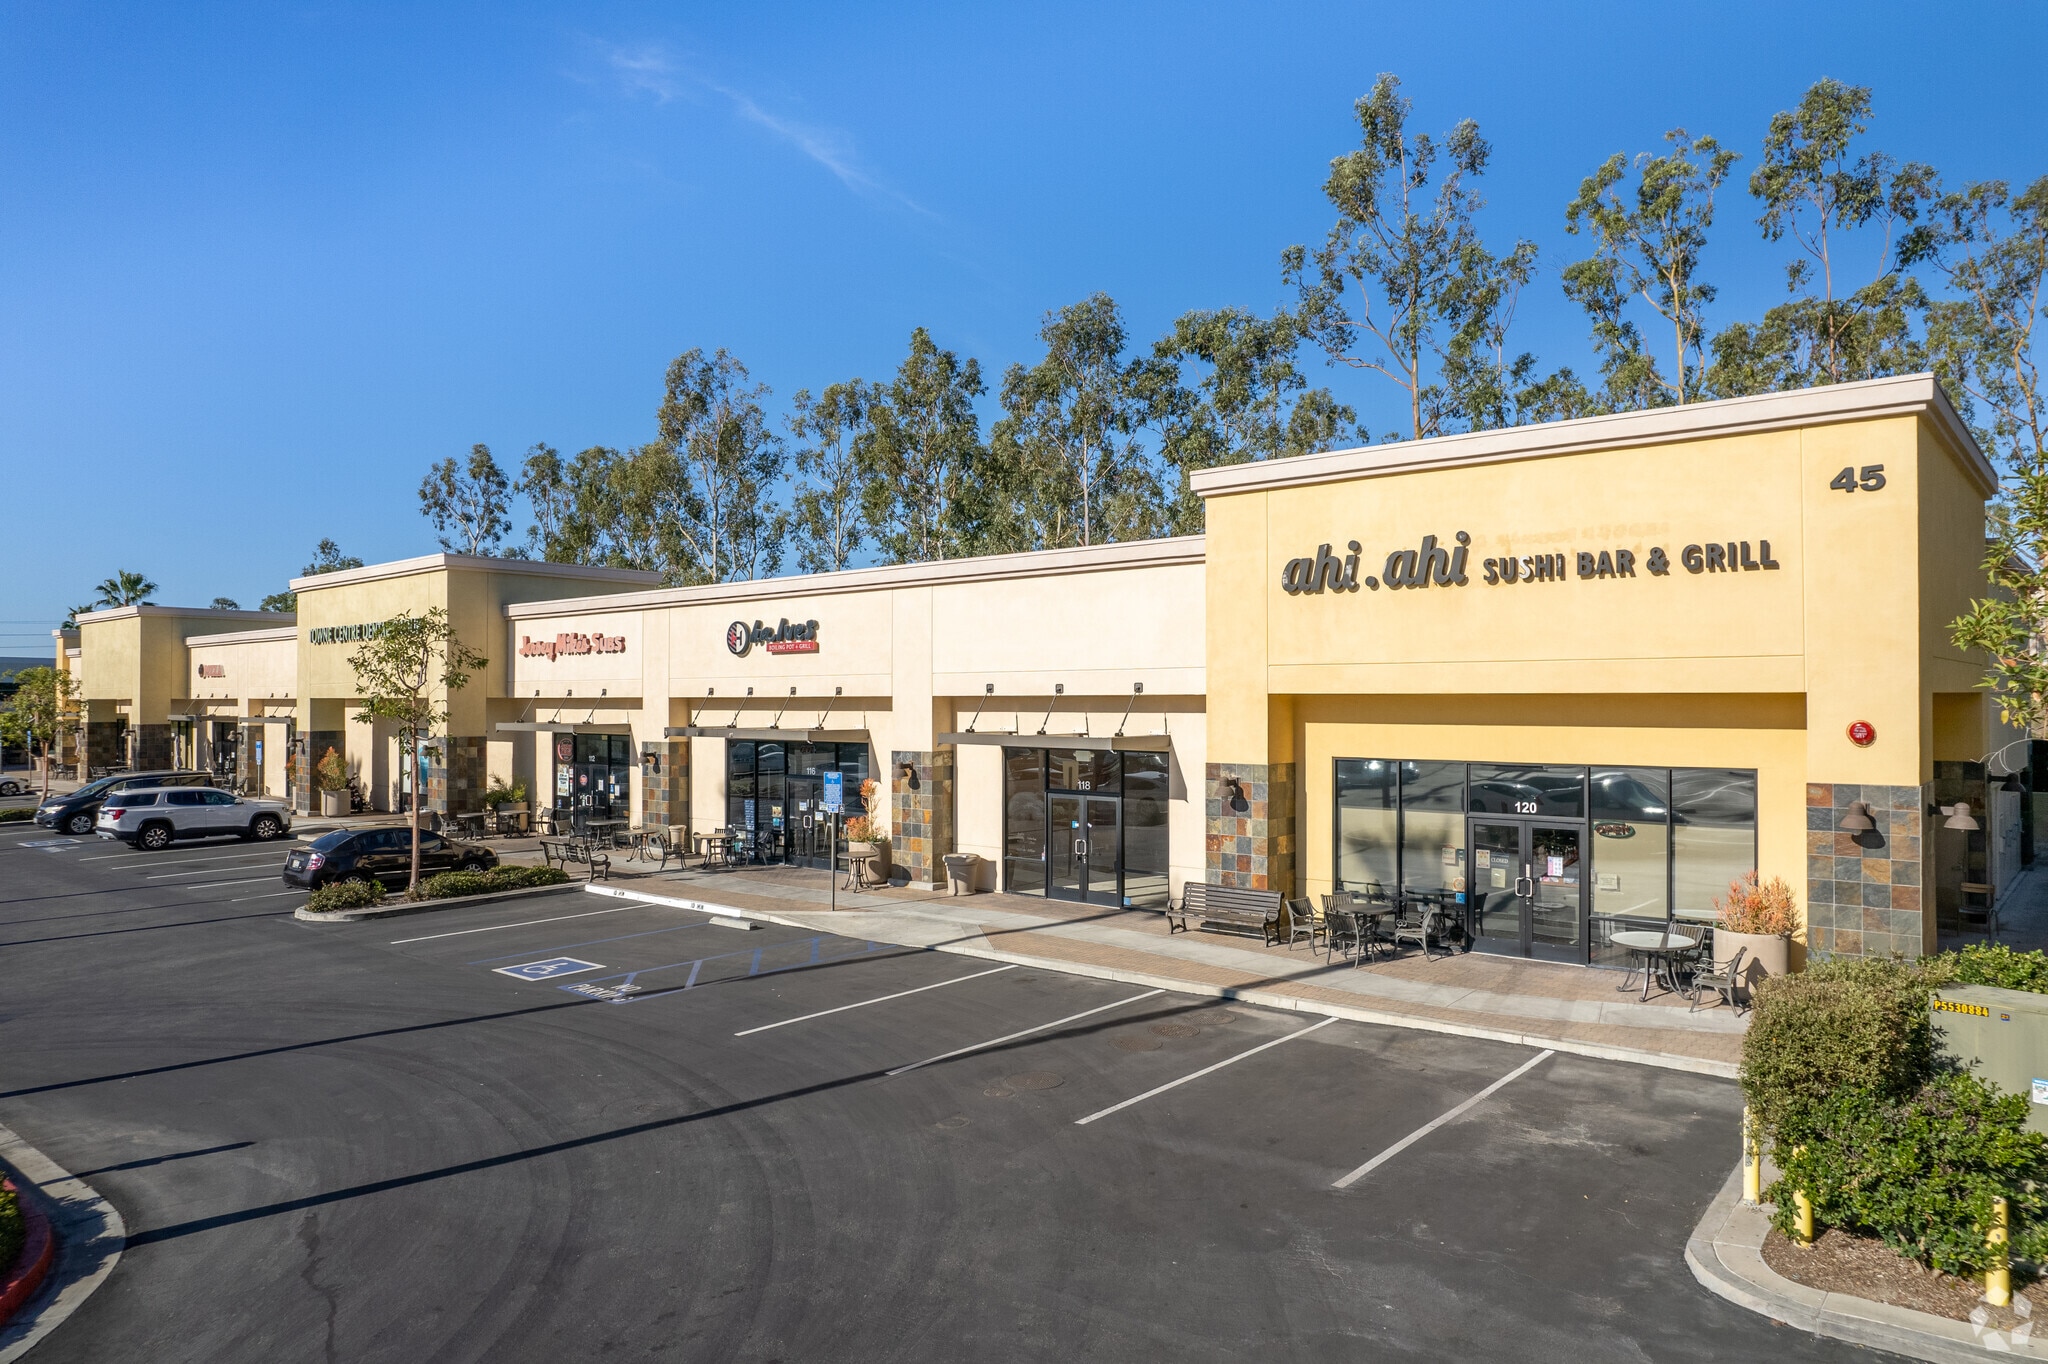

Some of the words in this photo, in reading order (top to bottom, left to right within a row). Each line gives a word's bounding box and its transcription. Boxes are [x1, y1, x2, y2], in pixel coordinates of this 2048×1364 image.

[1830, 464, 1886, 493] 45
[1483, 553, 1565, 585] SUSHI
[1577, 549, 1635, 579] BAR
[1647, 546, 1670, 575] &
[1681, 540, 1779, 573] GRILL
[334, 624, 361, 643] CENTRE
[806, 767, 816, 775] 116
[1077, 780, 1091, 790] 118
[1514, 801, 1538, 814] 120
[1595, 824, 1631, 836] OPEN
[1491, 857, 1509, 865] CLOSED
[1934, 1000, 1989, 1017] P5530884
